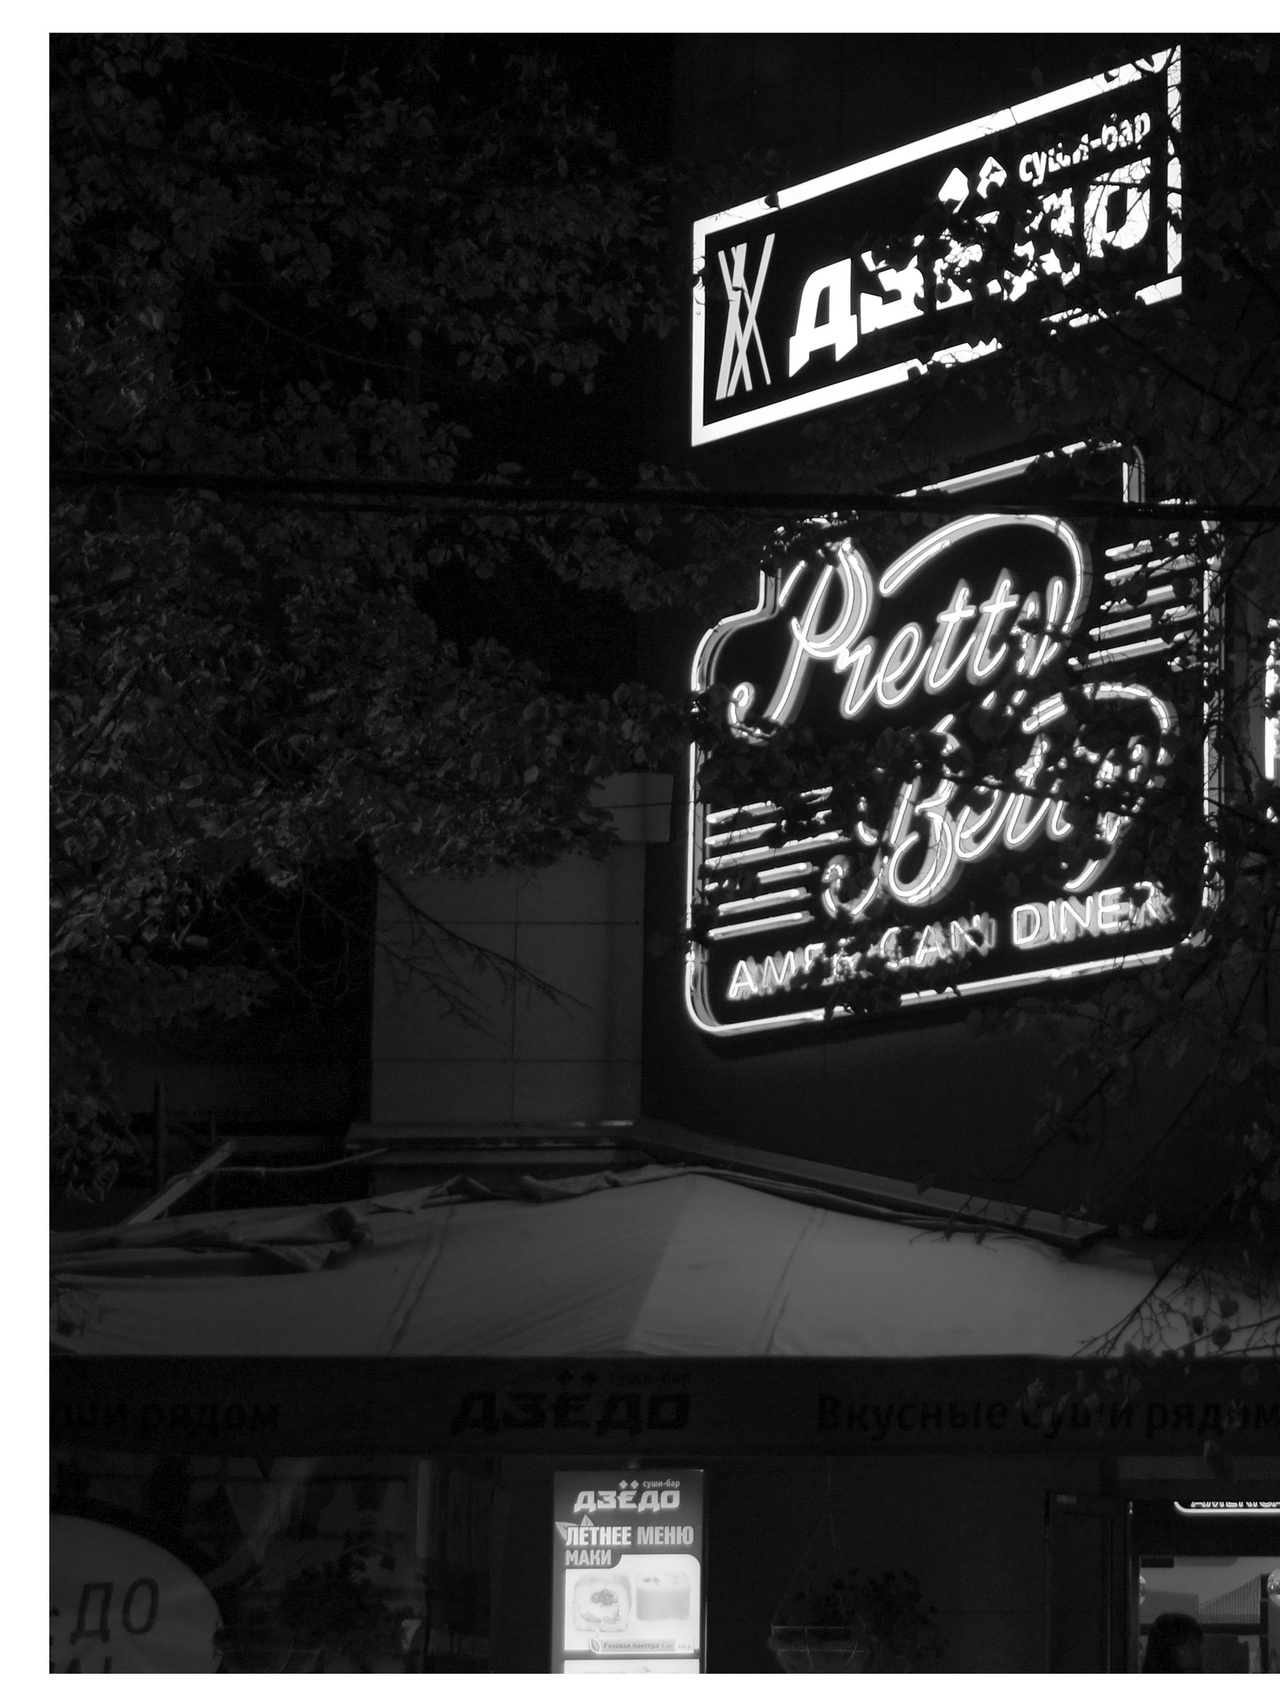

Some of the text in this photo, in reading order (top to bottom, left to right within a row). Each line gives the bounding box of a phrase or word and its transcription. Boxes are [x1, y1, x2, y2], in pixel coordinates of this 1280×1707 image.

[450, 1369, 692, 1436] ДЗЁДО
[815, 1394, 1008, 1441] Вкусные
[573, 1479, 681, 1513] ДЗЁДО
[642, 1478, 681, 1489] суши-бар
[566, 1525, 694, 1546] ЛЕТНЕЕ МЕНЮ
[565, 1549, 612, 1566] МАКИ
